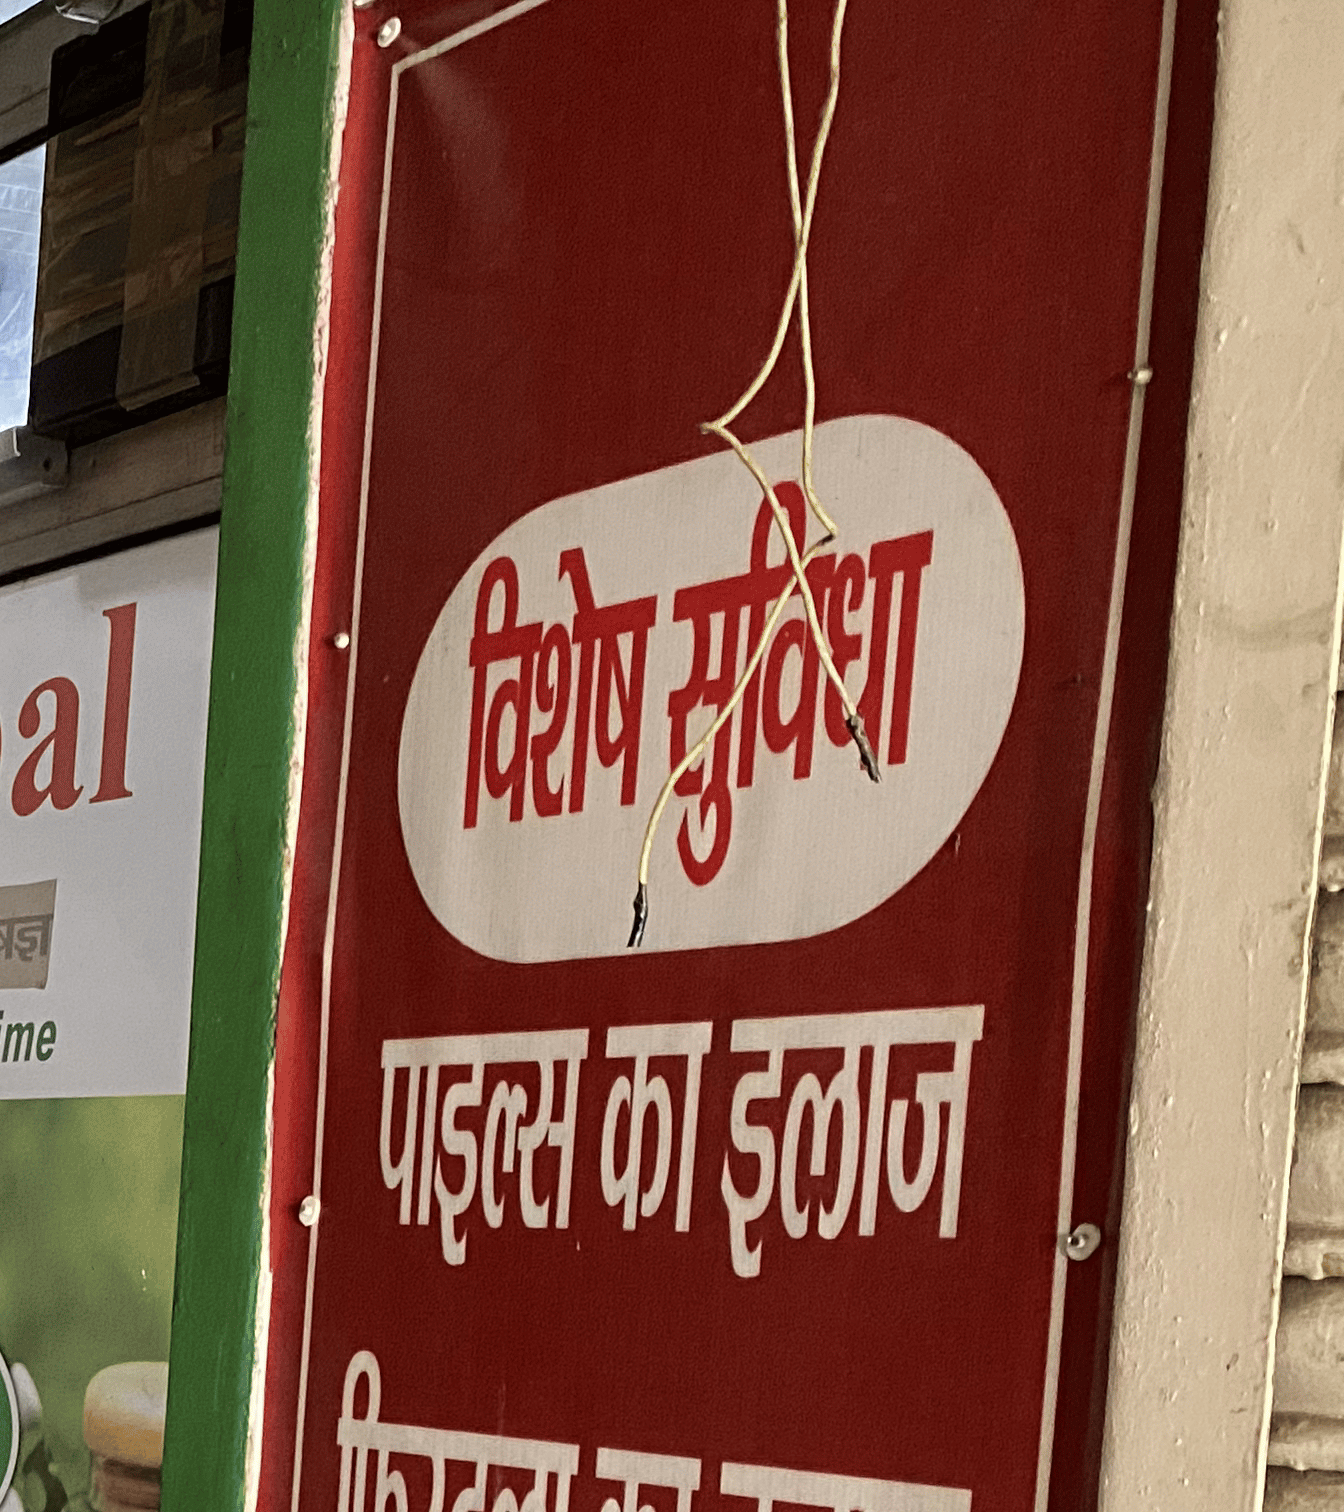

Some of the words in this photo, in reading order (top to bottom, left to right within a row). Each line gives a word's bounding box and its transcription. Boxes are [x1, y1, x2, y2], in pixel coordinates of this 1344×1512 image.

[463, 546, 658, 830] विशेष
[666, 480, 935, 887] सुविधा
[380, 1027, 590, 1265] पाइल्स
[600, 1021, 712, 1232] का
[721, 1005, 985, 1278] इलाज
